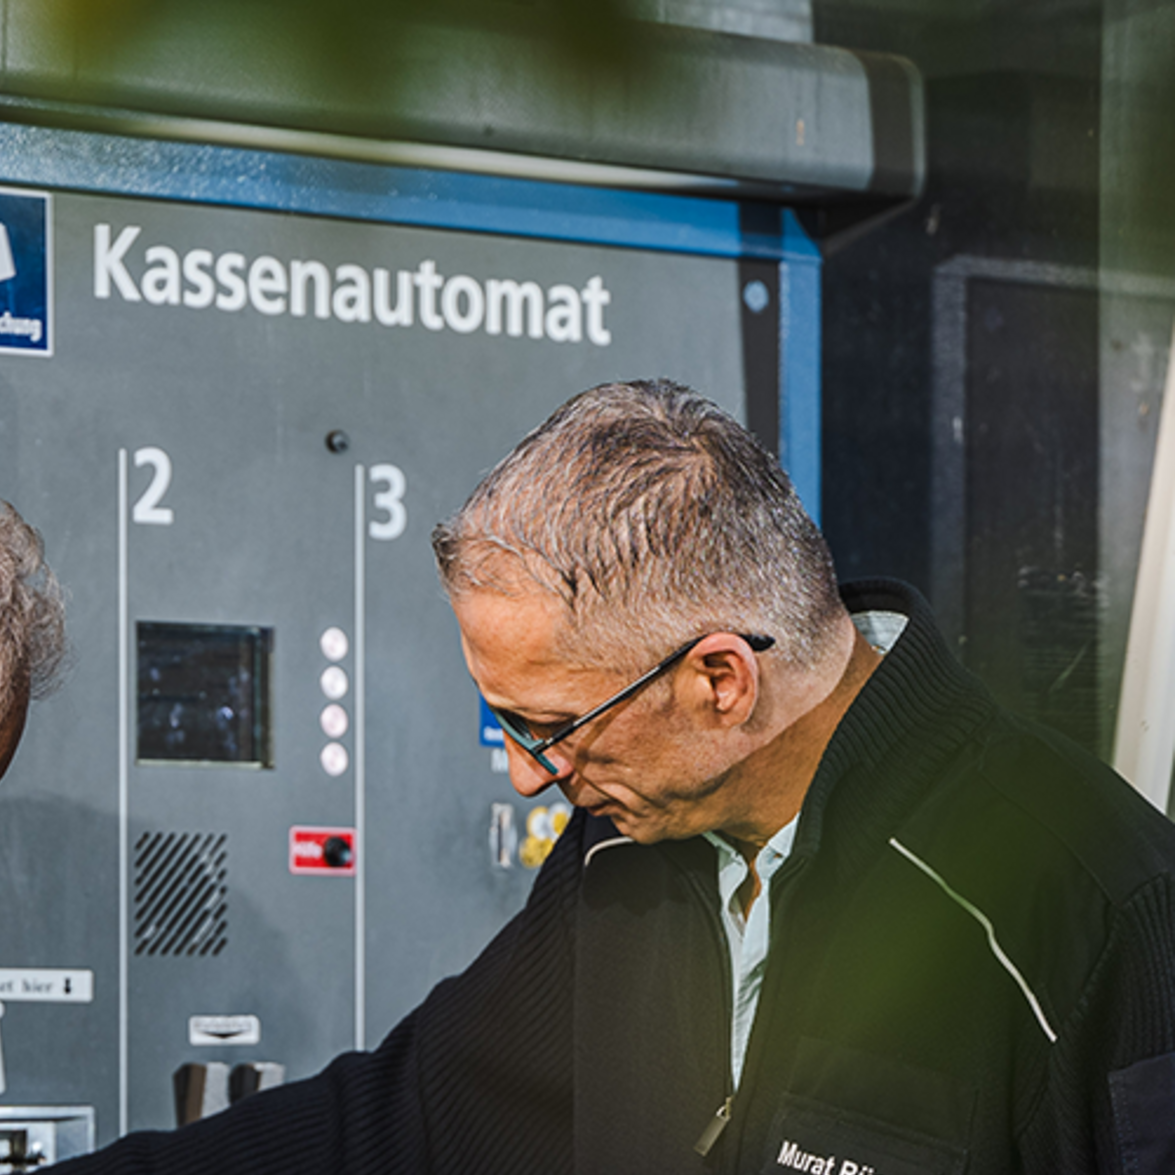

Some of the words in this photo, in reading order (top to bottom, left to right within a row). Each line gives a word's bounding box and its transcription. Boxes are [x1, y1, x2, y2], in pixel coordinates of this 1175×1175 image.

[93, 223, 612, 346] Kassenautomat
[132, 446, 173, 524] 2
[368, 463, 406, 540] 3
[20, 978, 54, 994] hier
